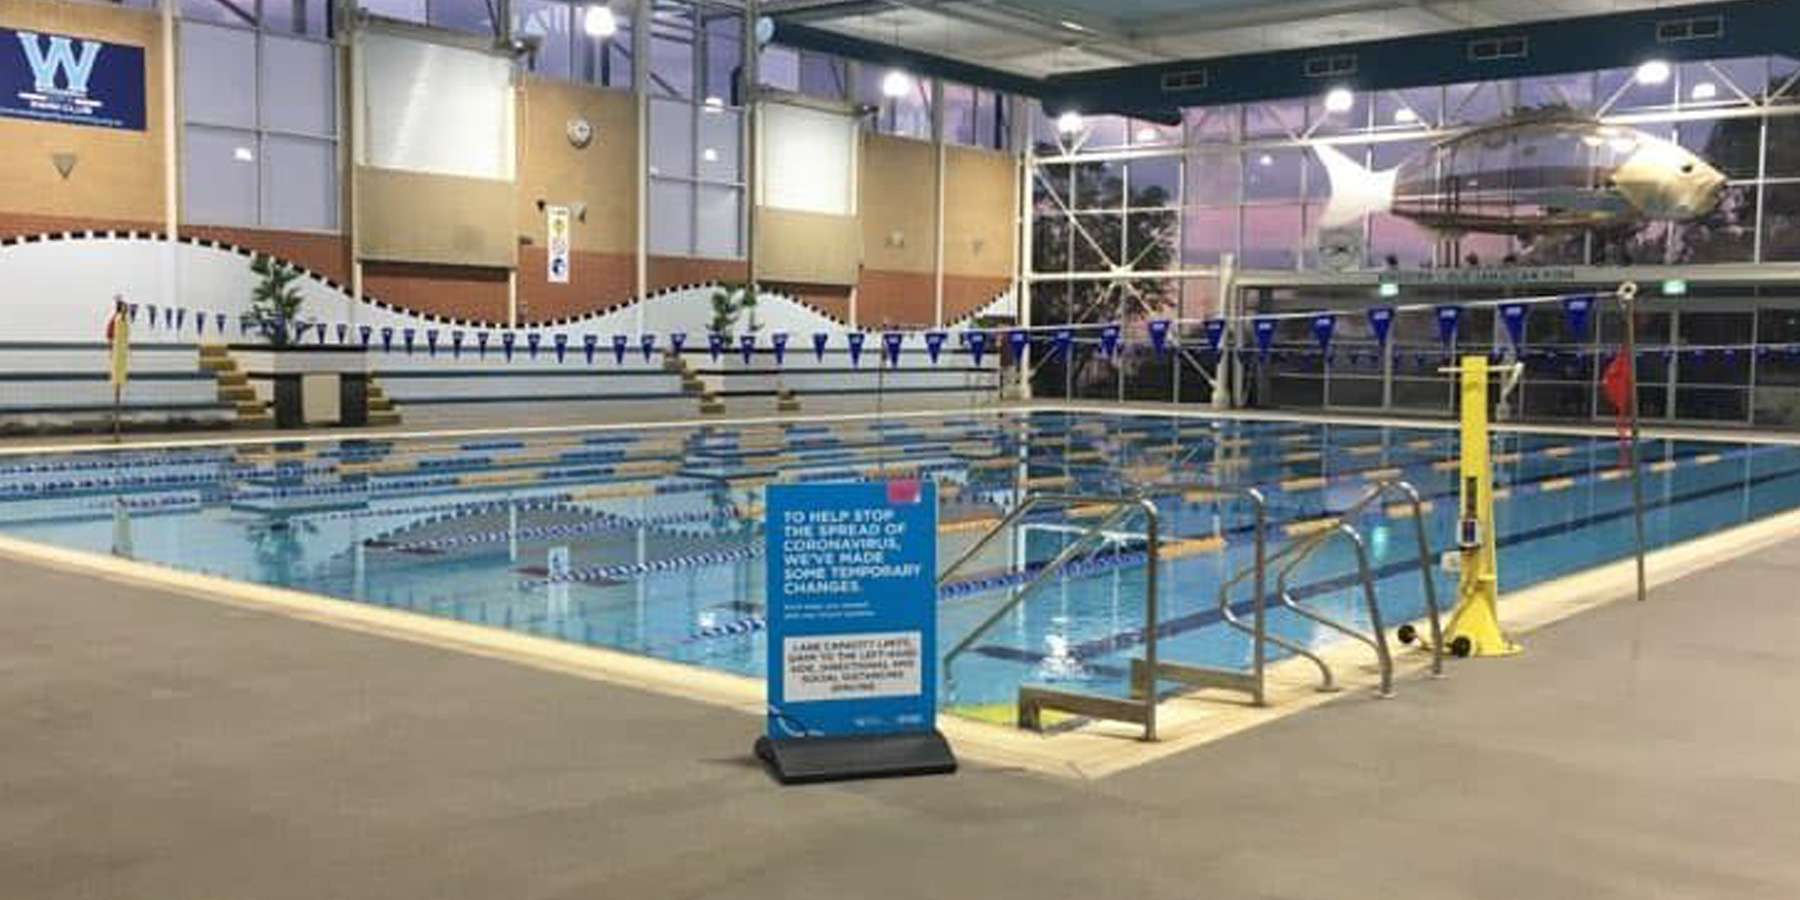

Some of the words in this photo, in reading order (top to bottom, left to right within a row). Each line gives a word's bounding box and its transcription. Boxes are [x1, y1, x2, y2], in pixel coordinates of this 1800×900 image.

[16, 31, 103, 94] W
[784, 510, 806, 523] TO
[809, 510, 849, 523] HELP
[853, 509, 894, 523] STOP
[784, 525, 814, 538] THE
[818, 523, 881, 537] SPREAD
[884, 522, 906, 535] OF
[784, 537, 902, 553] CORONAVIRUS,
[838, 550, 884, 565] MADE
[784, 567, 826, 580] SOME
[831, 562, 921, 578] TEMPORARY
